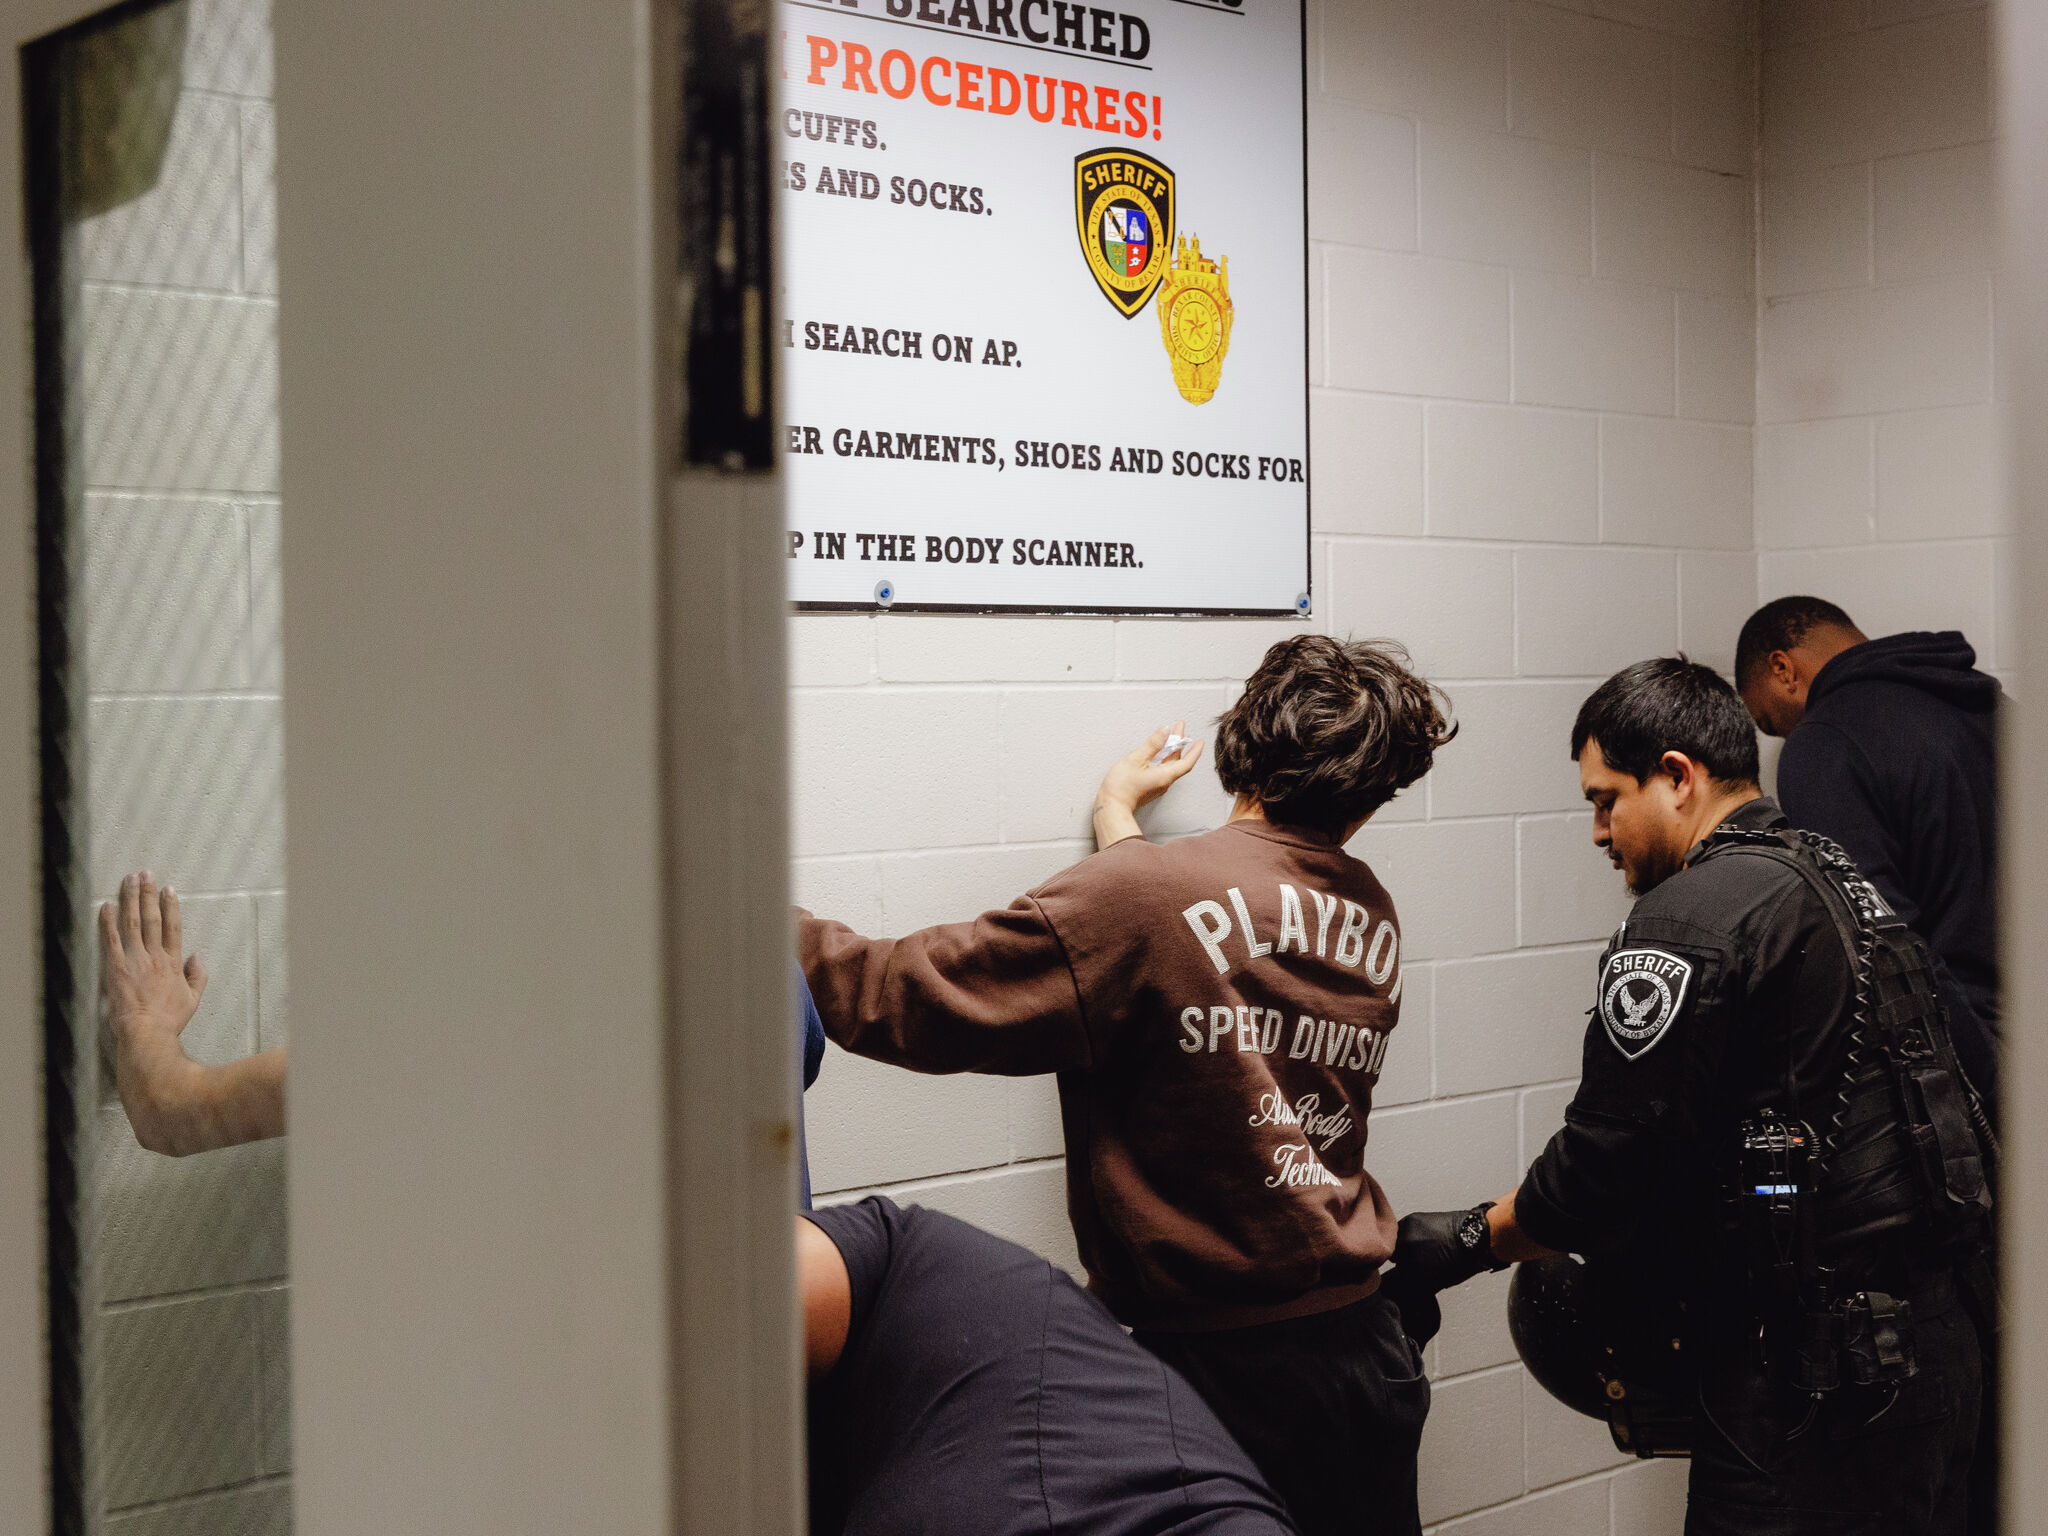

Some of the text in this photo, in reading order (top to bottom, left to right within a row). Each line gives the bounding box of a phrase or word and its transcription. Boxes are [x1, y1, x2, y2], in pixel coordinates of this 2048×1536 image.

[806, 34, 1162, 141] PROCEDURES!
[815, 165, 881, 201] AND
[890, 175, 993, 217] SOCKS.
[1084, 162, 1167, 199] SHERIFF
[1091, 188, 1160, 236] THE STATE OF TEXAS
[1091, 246, 1120, 286] COUNTY
[1124, 279, 1136, 289] OF
[804, 321, 922, 359] SEARCH
[932, 333, 973, 363] ON
[982, 338, 1022, 368] AP.
[833, 428, 1005, 472] GARMENTS,
[1015, 439, 1101, 471] SHOES
[1109, 447, 1163, 474] AND
[1172, 450, 1250, 480] SOCKS
[1258, 456, 1304, 483] FOR
[813, 531, 846, 560] IN
[856, 533, 916, 562] THE
[925, 536, 1004, 564] BODY
[1012, 538, 1143, 569] SCANNER.
[1607, 972, 1671, 1005] THE STATE OF TEXAS
[1612, 955, 1685, 979] SHERIFF
[1179, 1005, 1284, 1055] SPEED
[1606, 1010, 1666, 1039] COUNTY OF BEXAR
